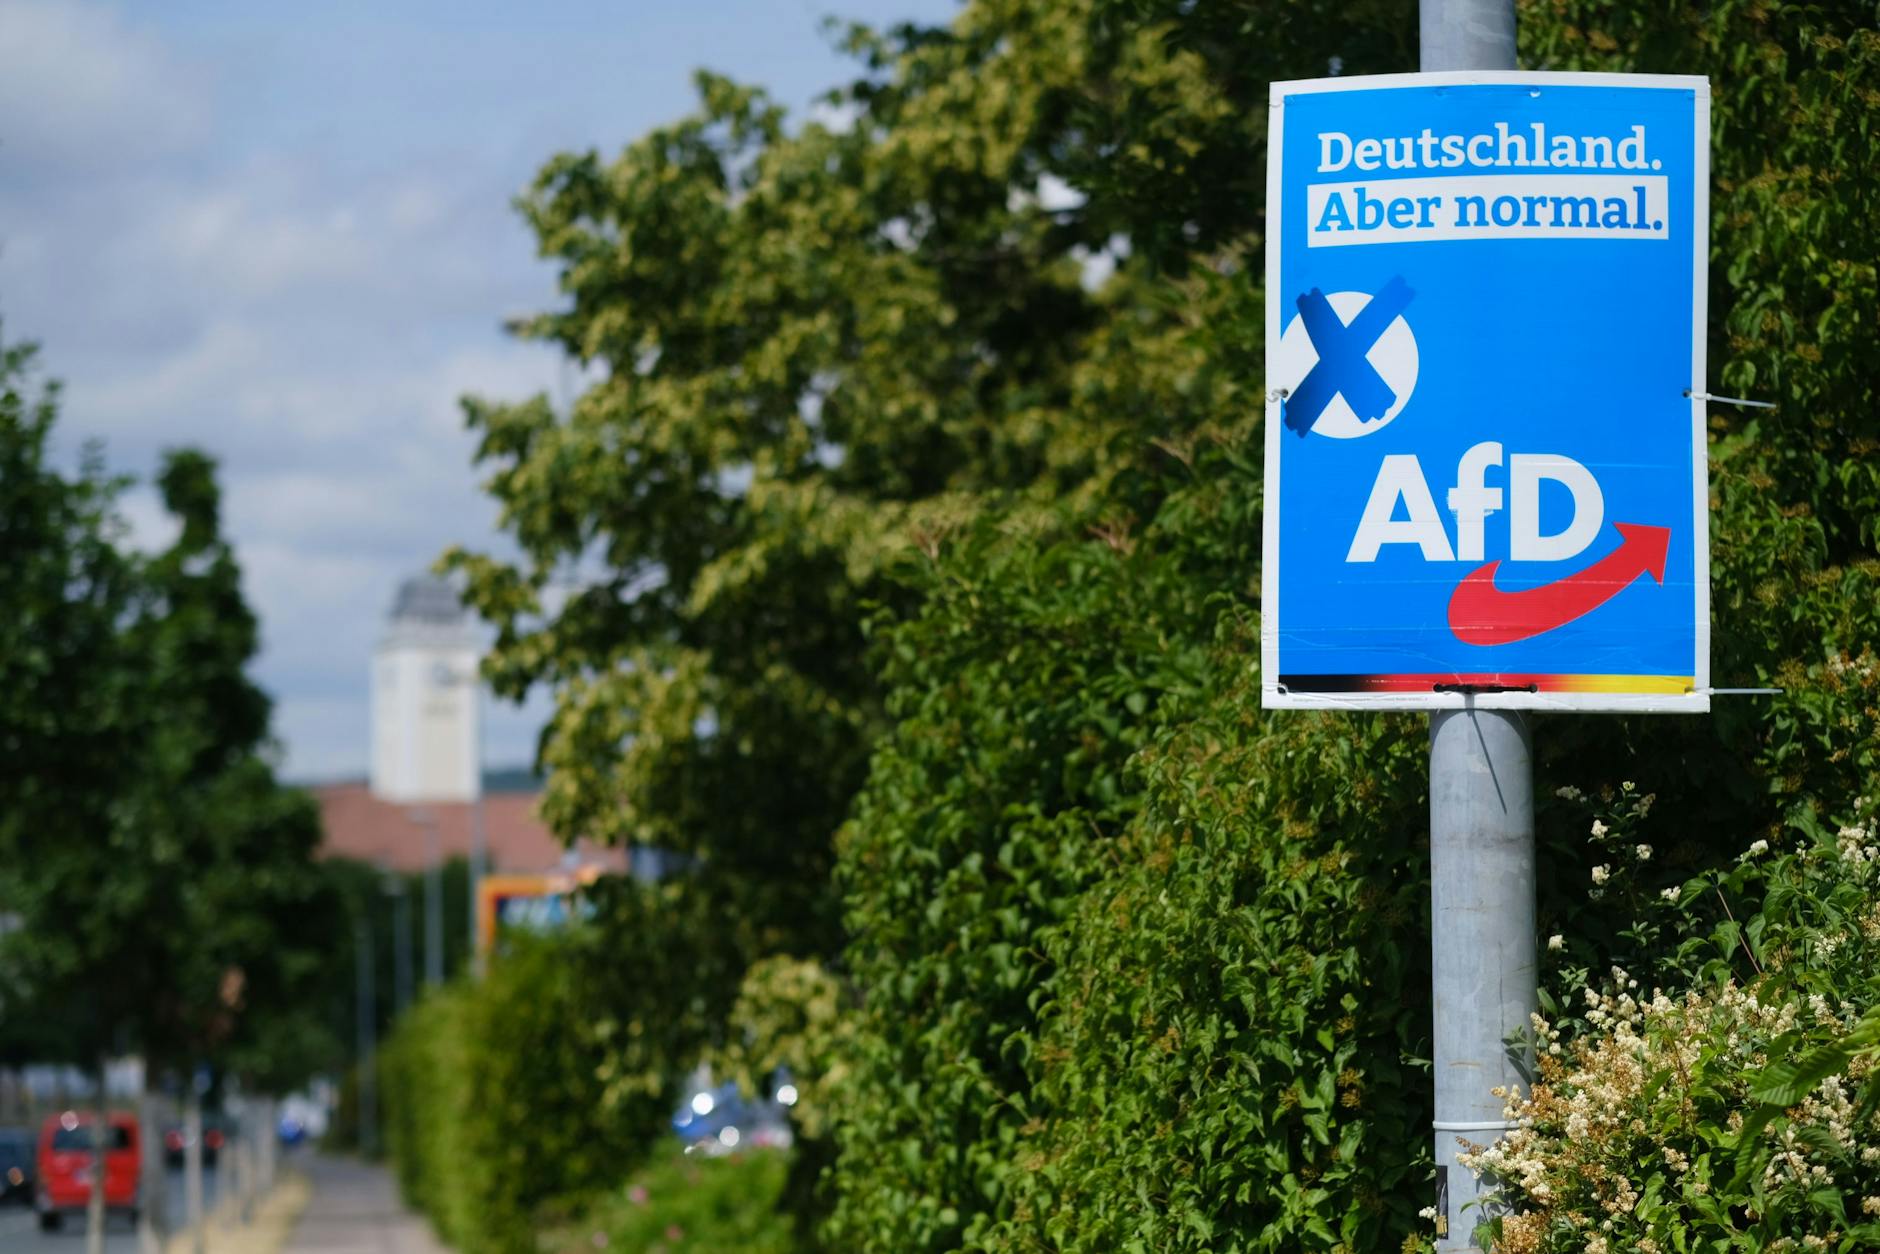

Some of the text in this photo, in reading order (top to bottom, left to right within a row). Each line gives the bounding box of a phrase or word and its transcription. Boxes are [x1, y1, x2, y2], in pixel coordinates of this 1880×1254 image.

[1317, 122, 1662, 172] Deutschland.
[1314, 186, 1663, 232] Aber normal.
[1345, 441, 1604, 562] AfD
